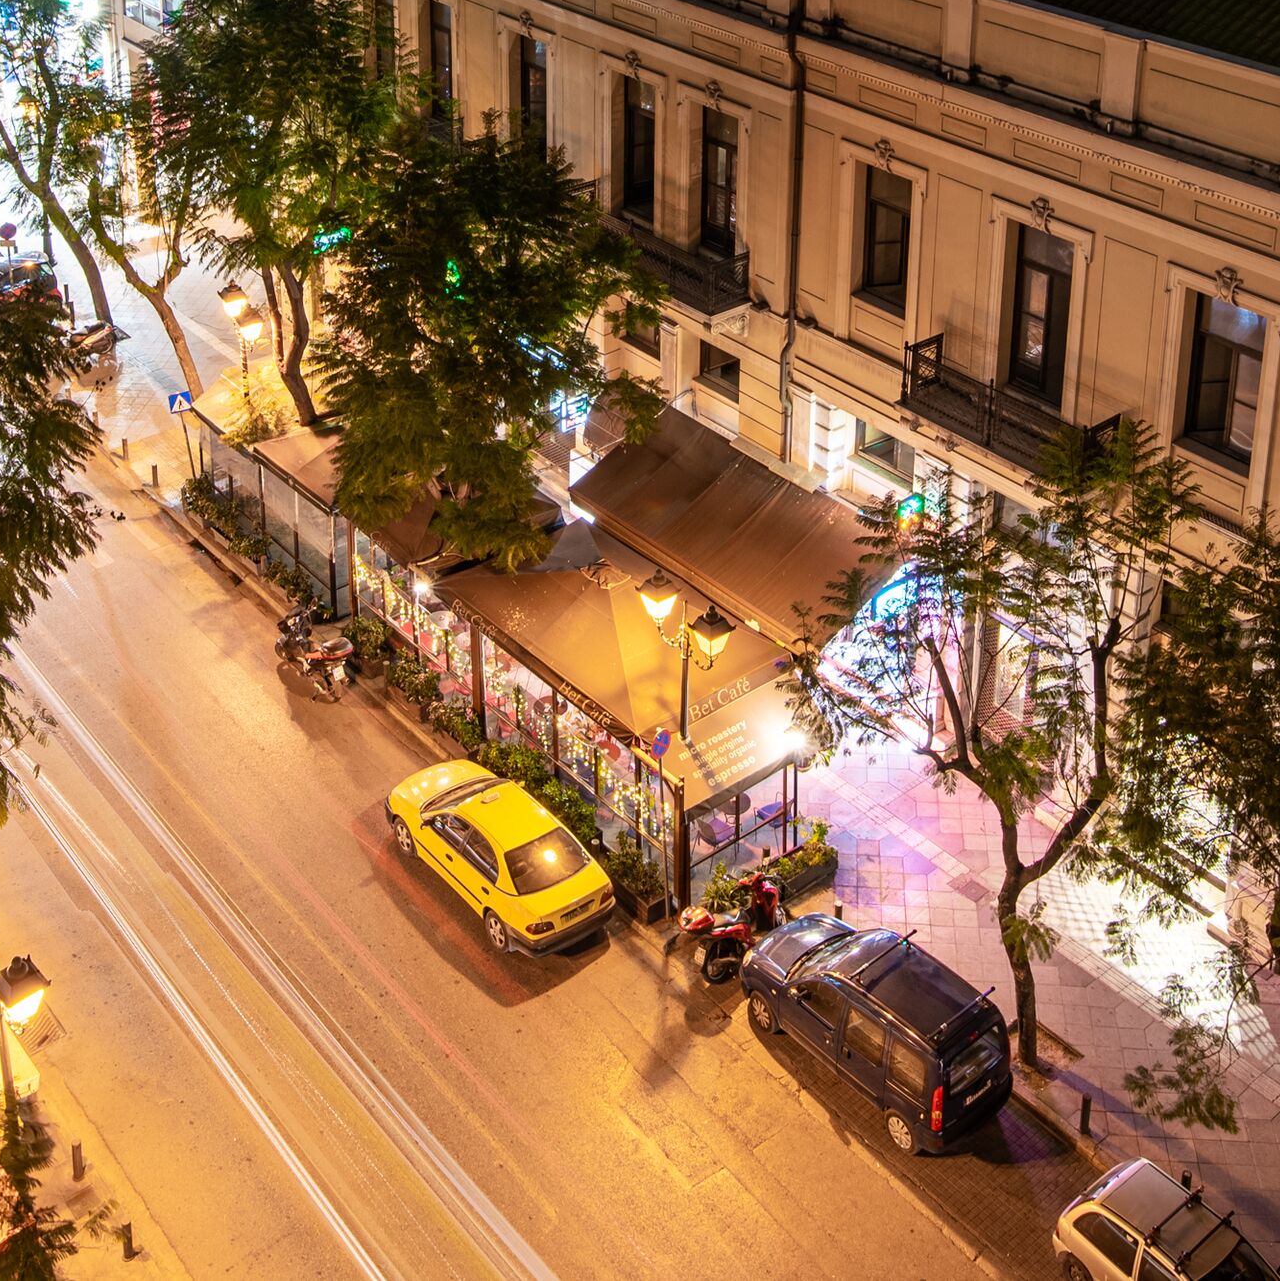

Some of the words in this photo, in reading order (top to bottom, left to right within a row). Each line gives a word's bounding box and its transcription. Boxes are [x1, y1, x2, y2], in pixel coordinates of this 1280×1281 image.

[559, 681, 581, 703] Bet
[582, 699, 613, 727] Café
[689, 700, 715, 721] Bet
[717, 677, 750, 705] Café
[678, 741, 706, 761] micro
[707, 719, 748, 747] roastery
[708, 755, 756, 787] espresso
